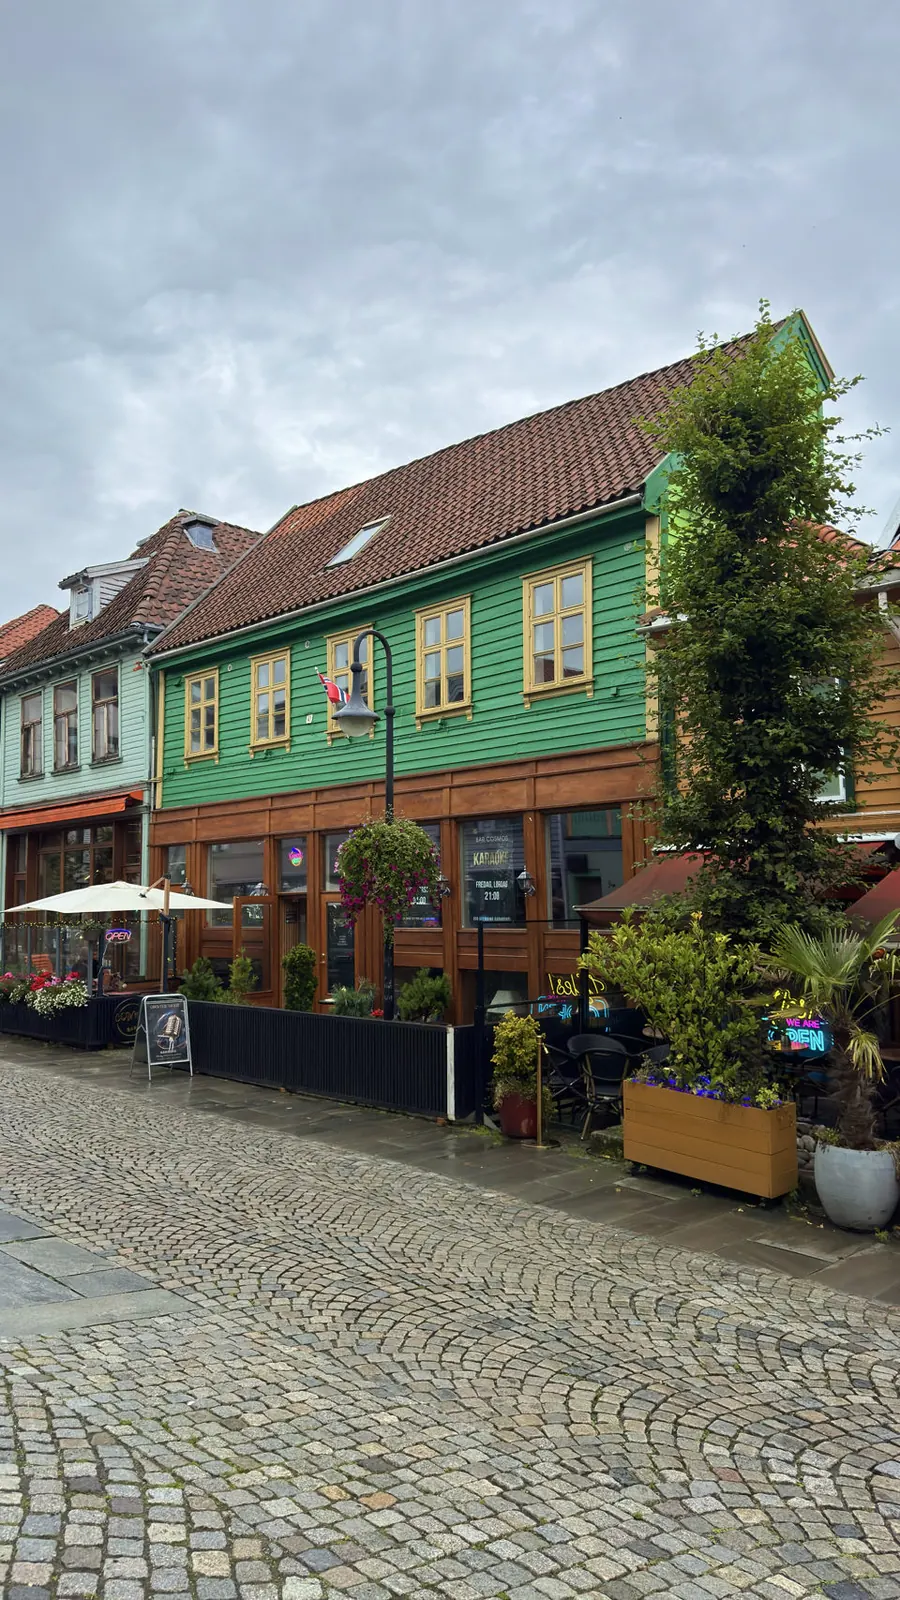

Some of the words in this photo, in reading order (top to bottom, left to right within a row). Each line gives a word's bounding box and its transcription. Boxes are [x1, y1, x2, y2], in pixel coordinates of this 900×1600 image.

[484, 891, 500, 901] 21:00
[105, 931, 131, 941] OPEN
[785, 1018, 800, 1027] WE
[802, 1019, 820, 1029] ARE
[768, 1028, 825, 1051] PEN
